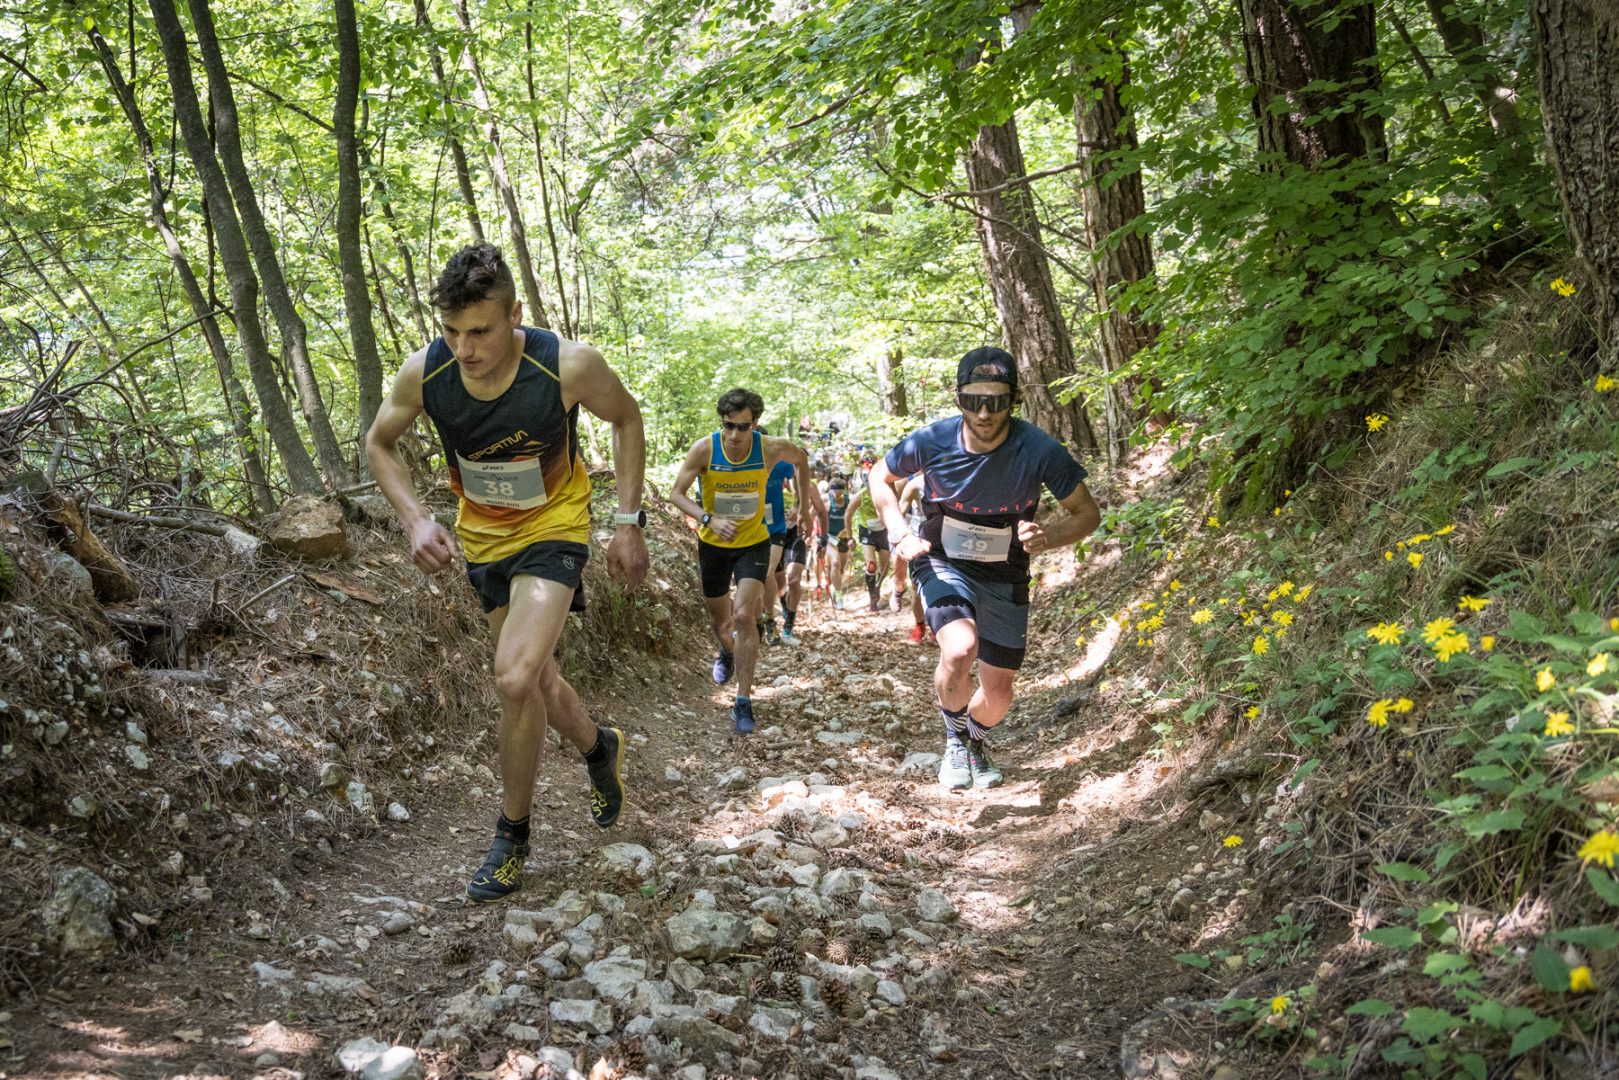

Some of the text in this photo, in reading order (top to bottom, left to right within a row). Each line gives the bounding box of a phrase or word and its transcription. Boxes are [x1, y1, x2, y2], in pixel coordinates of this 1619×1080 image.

[468, 430, 528, 461] SPORTIVA
[483, 480, 514, 496] 38
[732, 503, 741, 513] 6
[961, 539, 988, 551] 49
